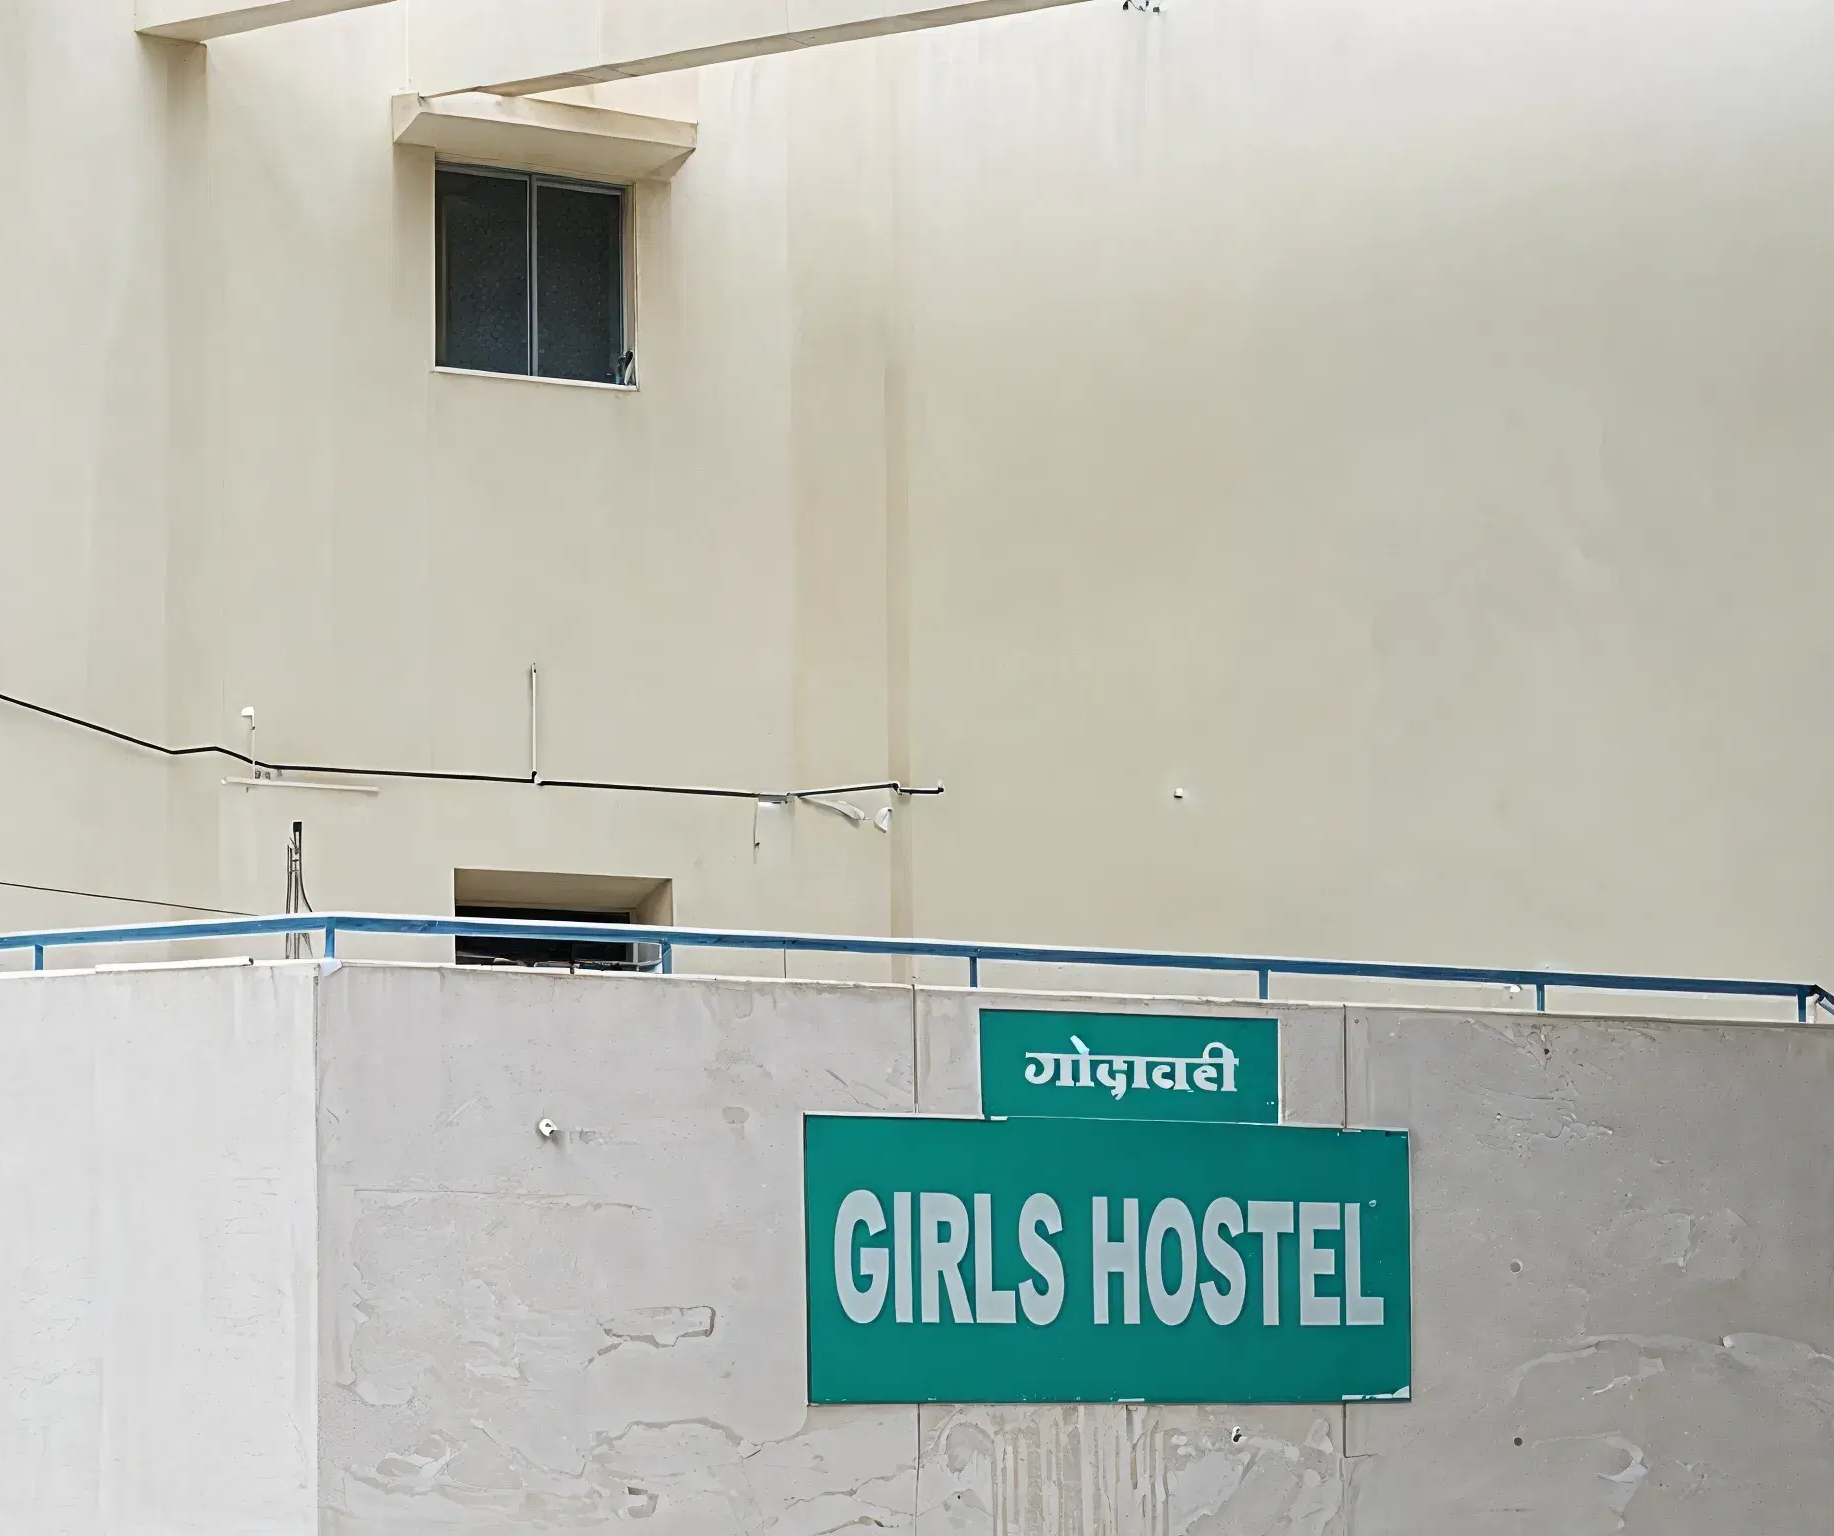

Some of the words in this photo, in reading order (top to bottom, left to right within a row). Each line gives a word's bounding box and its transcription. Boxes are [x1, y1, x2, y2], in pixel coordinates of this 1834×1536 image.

[1025, 1035, 1239, 1100] गोदावरी
[834, 1189, 1065, 1326] GIRLS
[1092, 1196, 1384, 1327] HOSTEL
